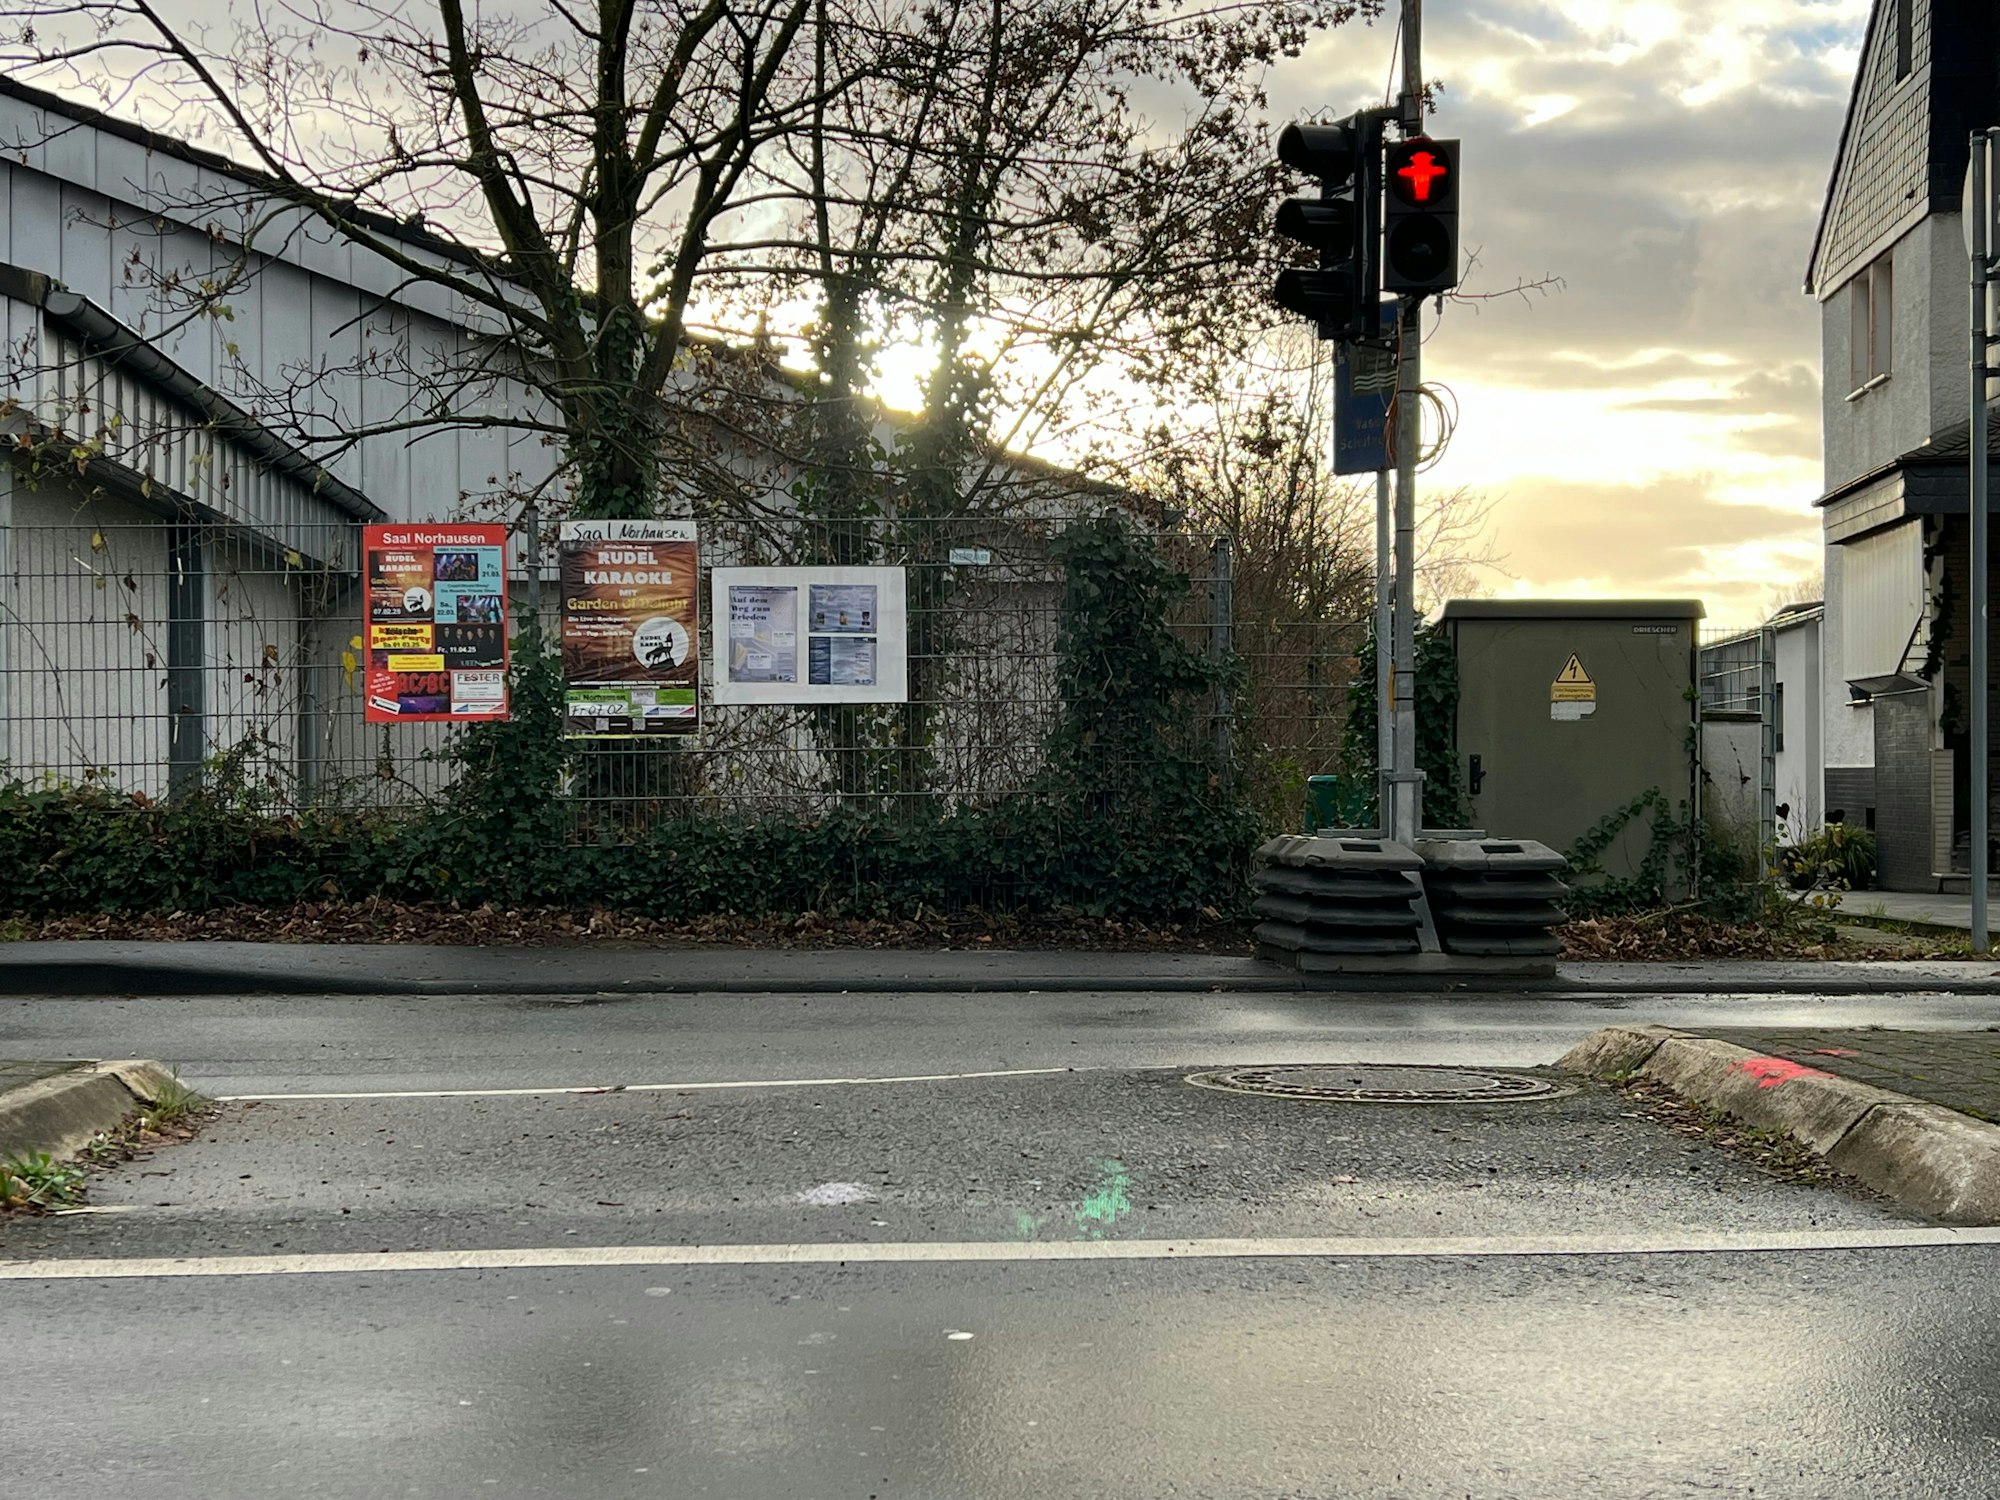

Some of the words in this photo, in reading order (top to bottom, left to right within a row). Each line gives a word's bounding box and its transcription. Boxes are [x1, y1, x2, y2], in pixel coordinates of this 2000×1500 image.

[573, 522, 611, 541] Saal
[619, 523, 690, 540] Norhausen
[382, 532, 411, 544] Saal
[414, 532, 486, 544] Norhausen
[597, 551, 659, 565] RUDEL
[379, 564, 423, 572] KARAOKE
[583, 571, 673, 585] KARAOKE
[619, 589, 639, 597] MIT
[567, 598, 618, 610] Garden
[733, 596, 747, 604] Auf
[749, 596, 768, 604] dem
[731, 613, 767, 621] Frieden
[457, 673, 500, 682] FESTER
